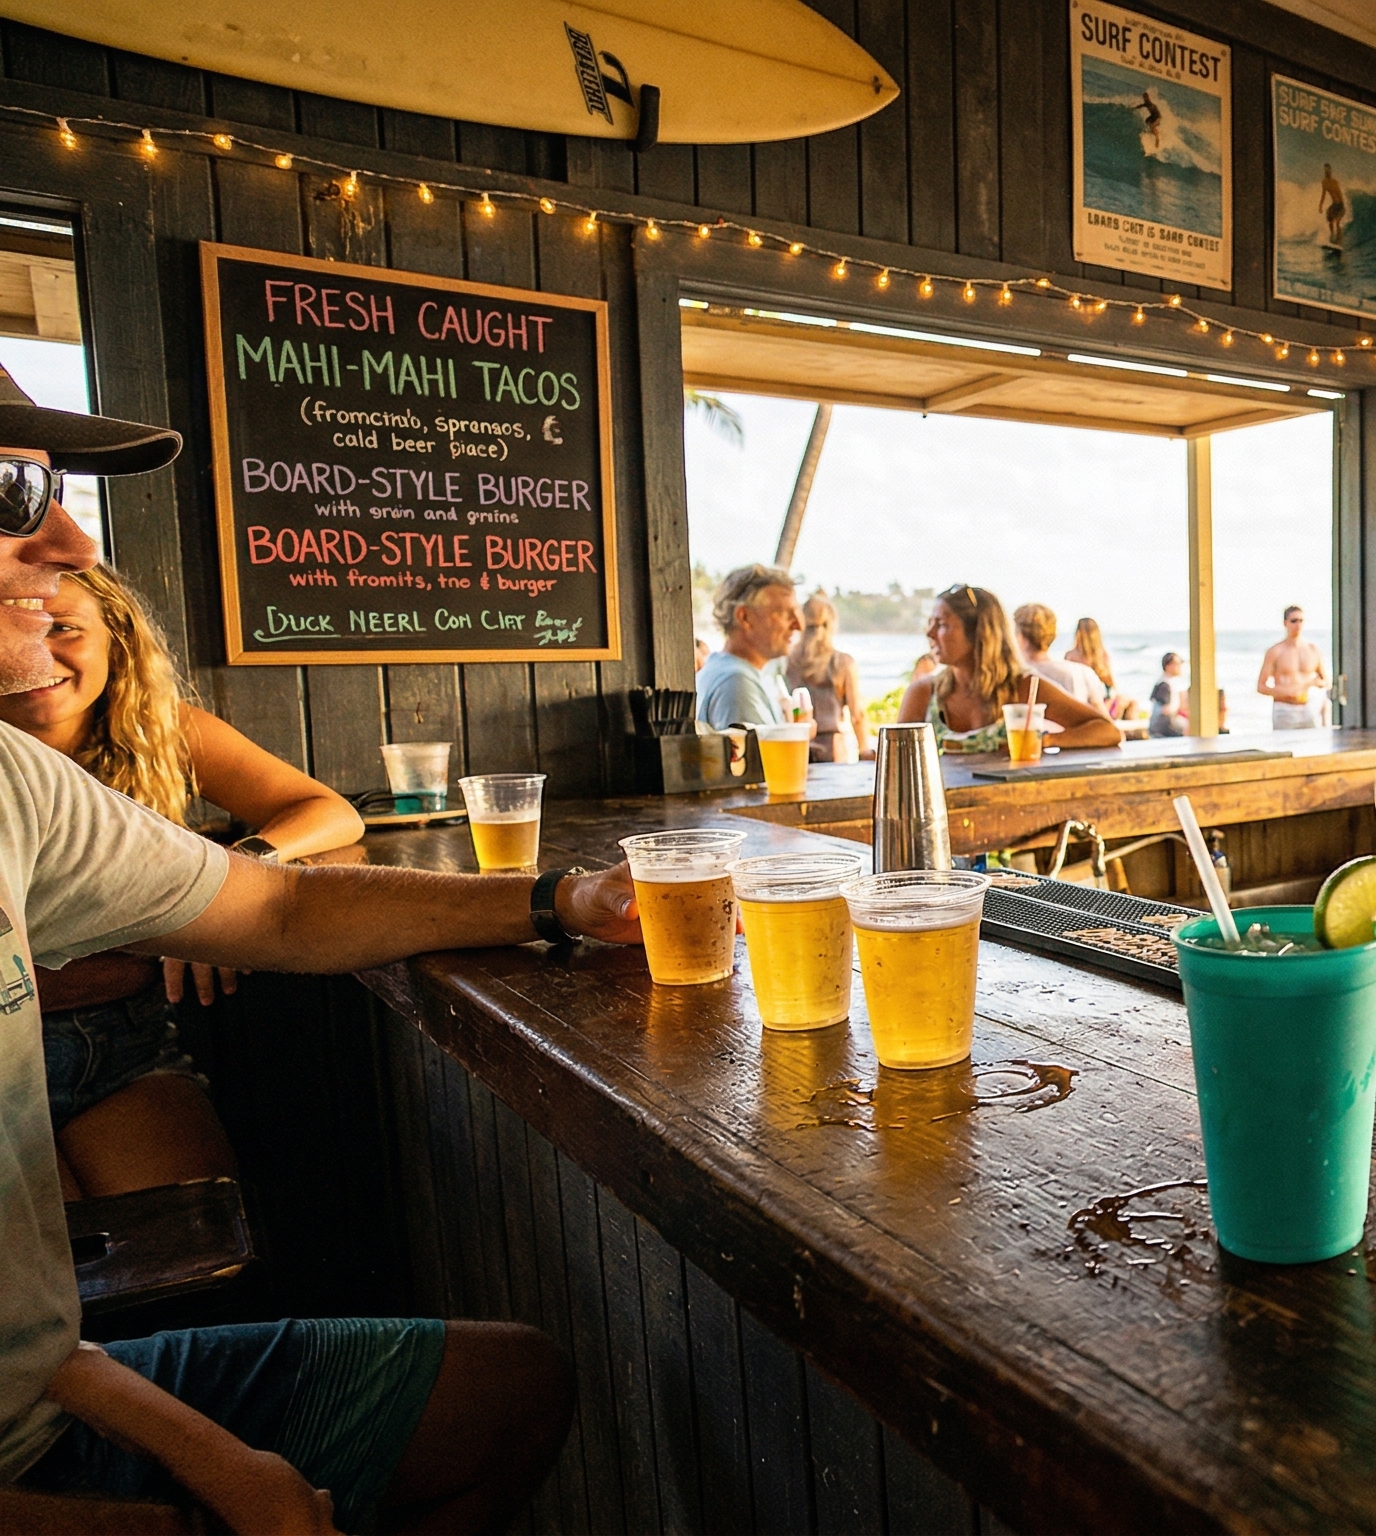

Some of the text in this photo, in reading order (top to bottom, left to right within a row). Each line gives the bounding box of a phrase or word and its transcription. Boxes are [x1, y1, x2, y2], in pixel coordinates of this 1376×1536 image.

[1081, 12, 1132, 53] SURF
[1139, 32, 1221, 82] CONTEST
[1279, 106, 1319, 134] SURF
[265, 279, 553, 353] FRESH CAUGHT
[236, 333, 580, 410] MAHI-MAHI TACOS
[333, 429, 378, 449] cald
[391, 432, 436, 453] beer
[242, 457, 591, 511] BOARD-STYLE BURGER
[314, 499, 360, 518] with
[424, 507, 458, 521] and
[247, 525, 597, 574] BOARD-STYLE BURGER
[289, 568, 338, 587] with
[497, 574, 557, 598] burger
